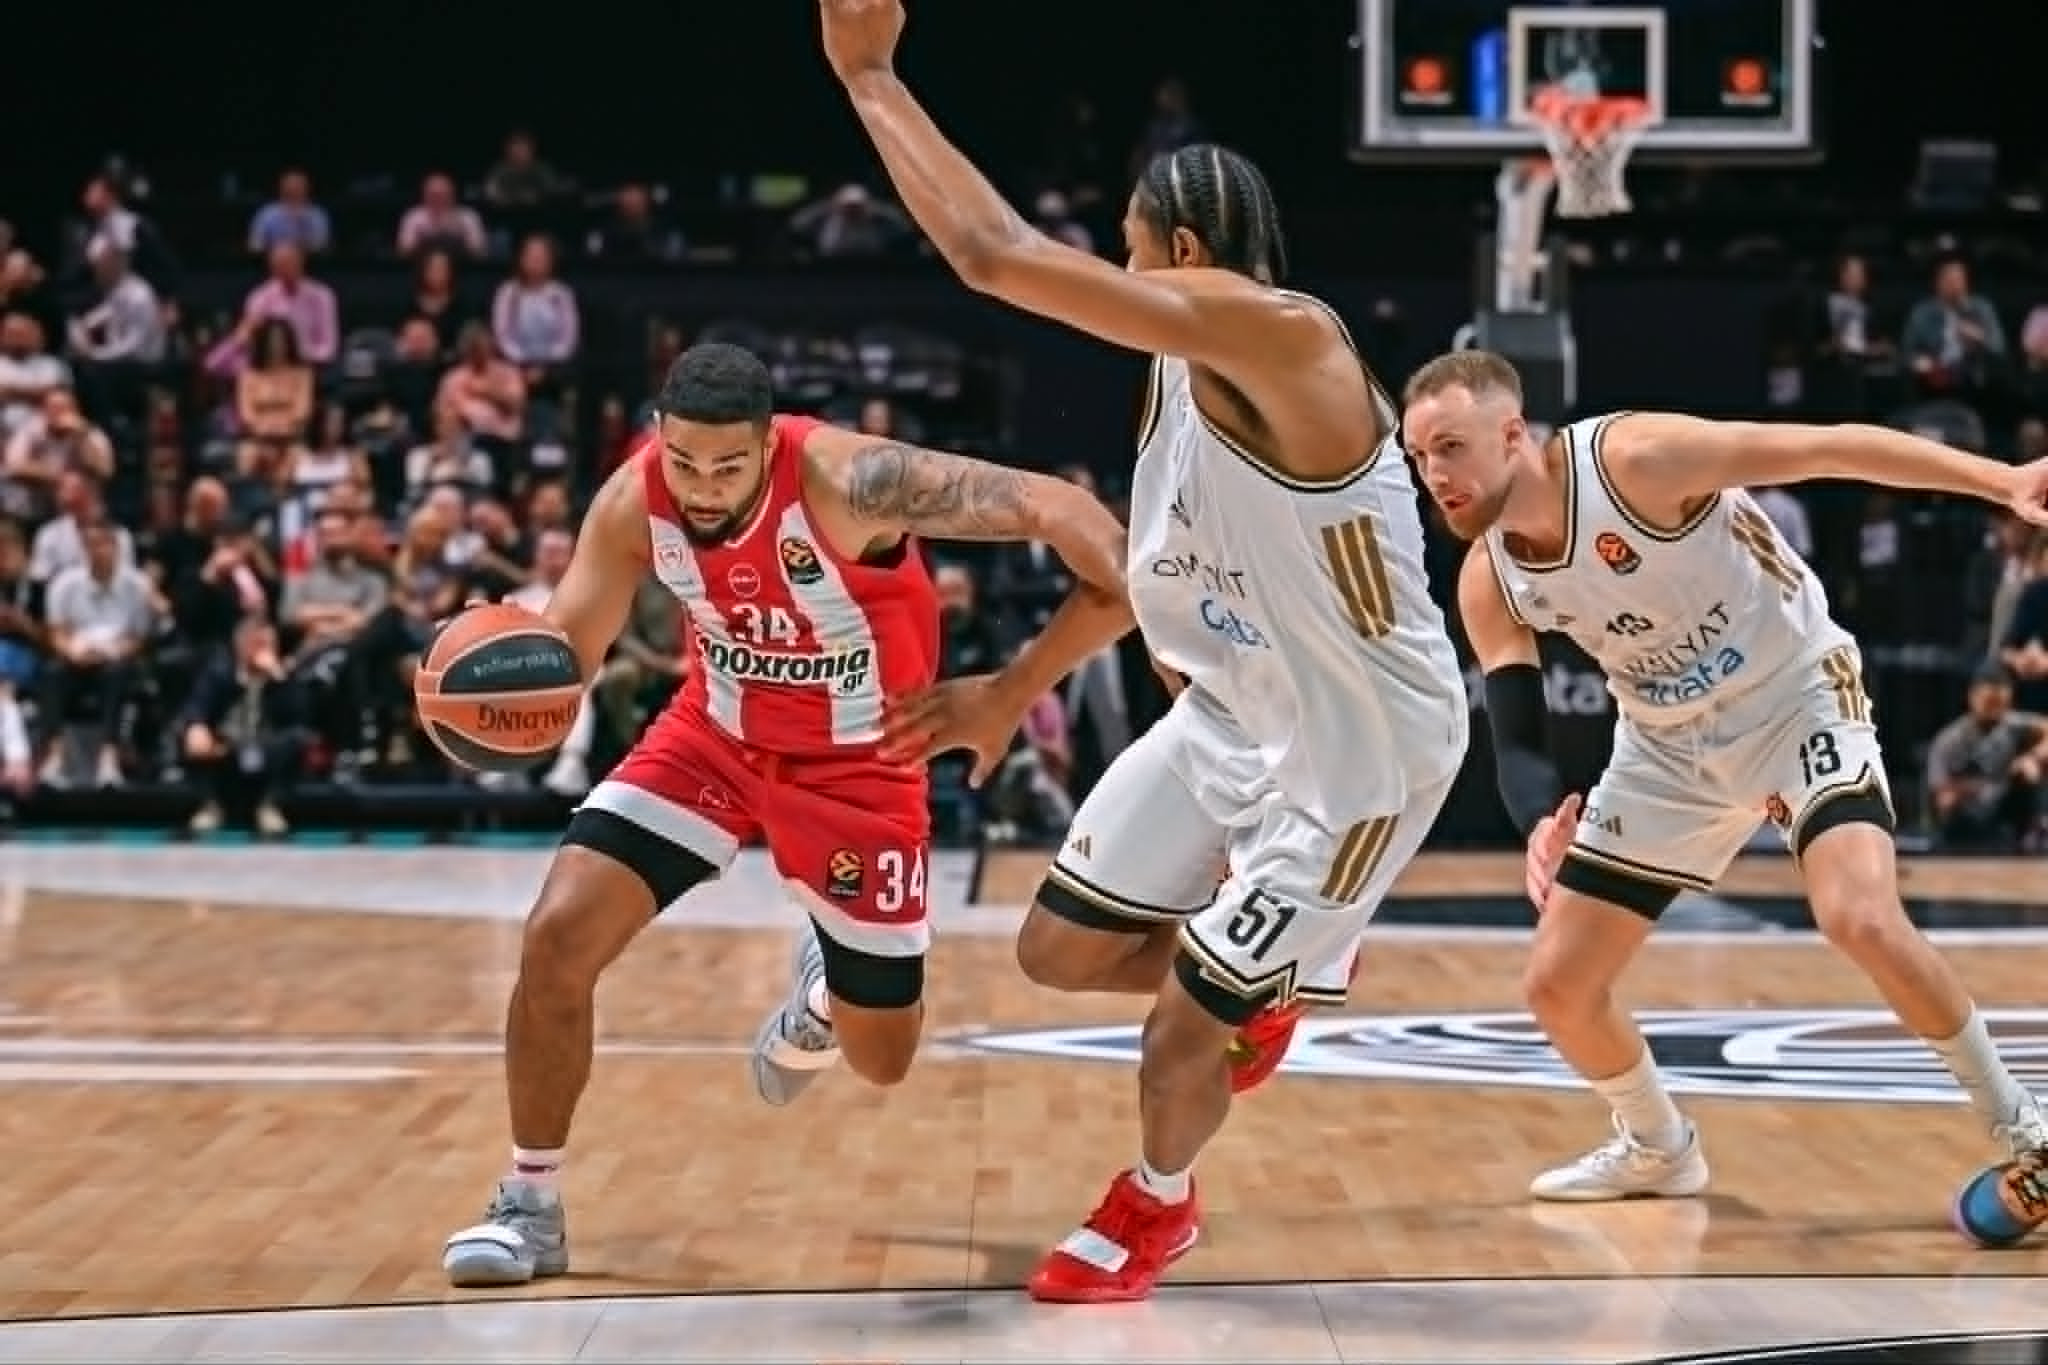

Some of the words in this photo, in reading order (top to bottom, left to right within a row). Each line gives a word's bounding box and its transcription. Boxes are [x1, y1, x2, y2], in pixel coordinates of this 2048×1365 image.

[730, 603, 799, 648] 34
[1800, 731, 1842, 787] 13
[875, 849, 929, 913] 34
[1226, 886, 1299, 961] 51
